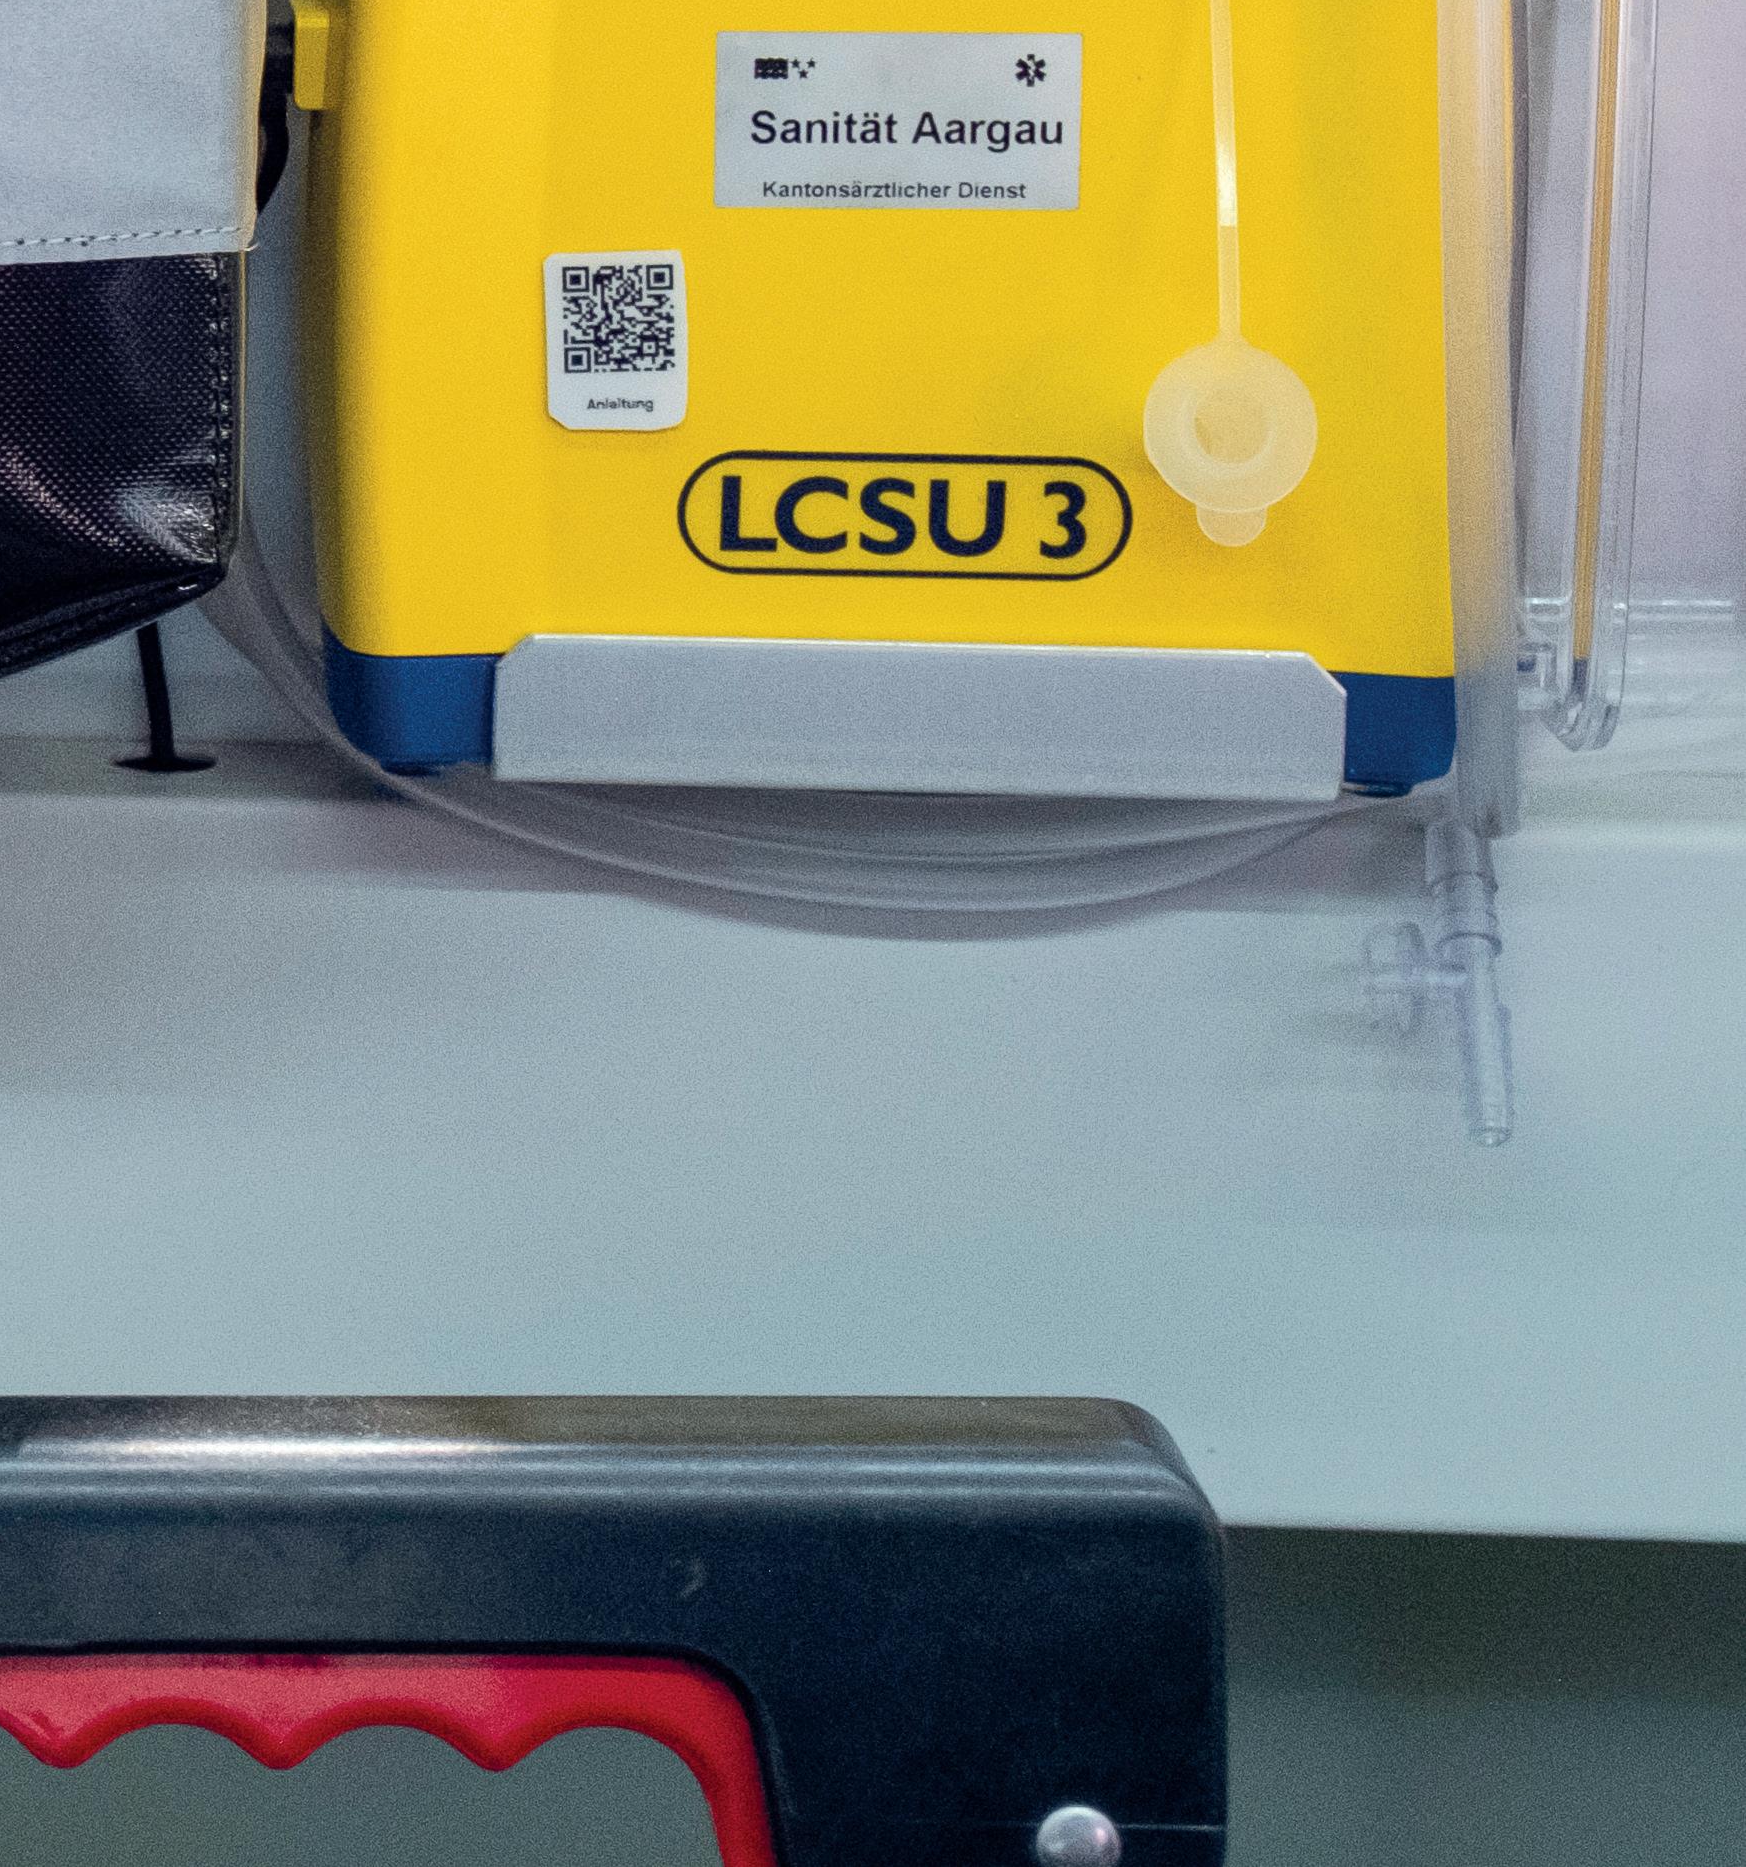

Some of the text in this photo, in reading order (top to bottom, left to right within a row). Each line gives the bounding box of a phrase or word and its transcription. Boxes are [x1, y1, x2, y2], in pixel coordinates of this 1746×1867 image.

[752, 110, 1062, 153] Sanität Aargau
[763, 182, 1026, 198] Kantonsärztlicher Dienst
[718, 475, 1086, 559] LCSU 3
